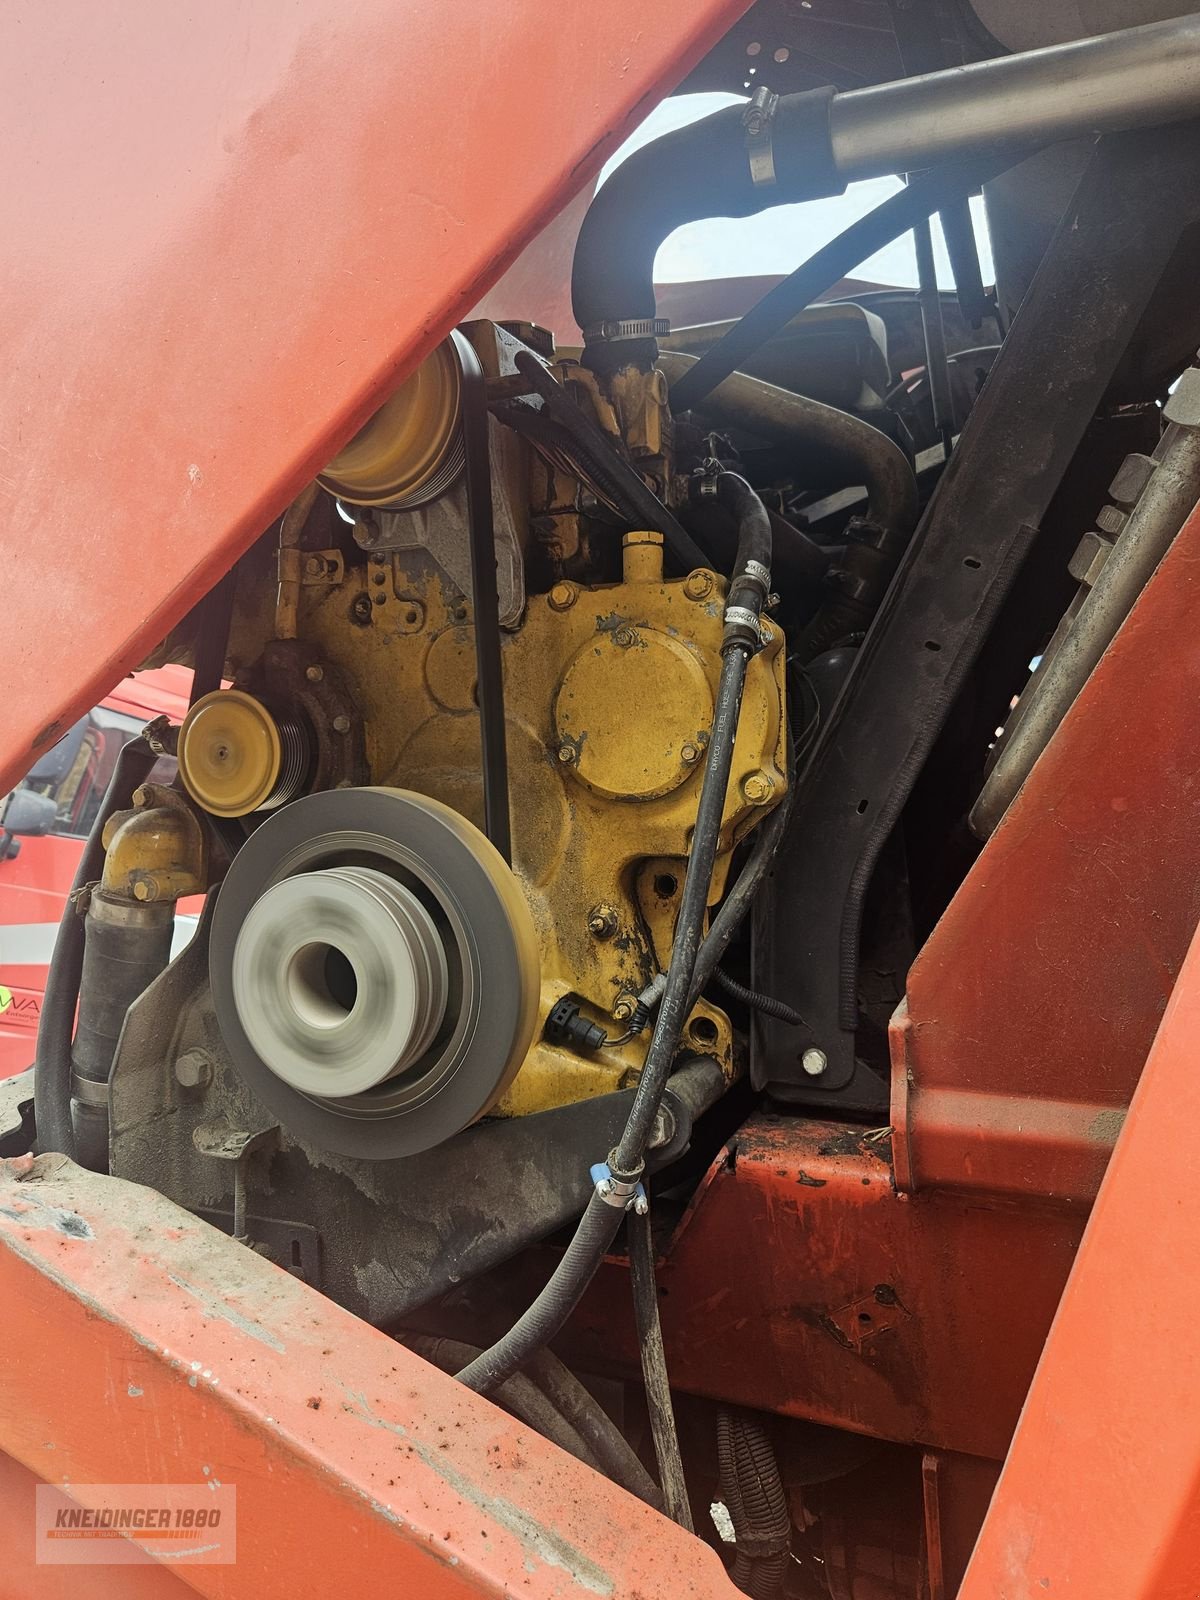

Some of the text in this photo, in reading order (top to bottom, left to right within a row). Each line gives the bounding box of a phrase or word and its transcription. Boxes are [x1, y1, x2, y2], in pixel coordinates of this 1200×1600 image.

[722, 689, 730, 709] HOSE
[717, 713, 728, 732] FUEL
[710, 745, 721, 771] DAYCO
